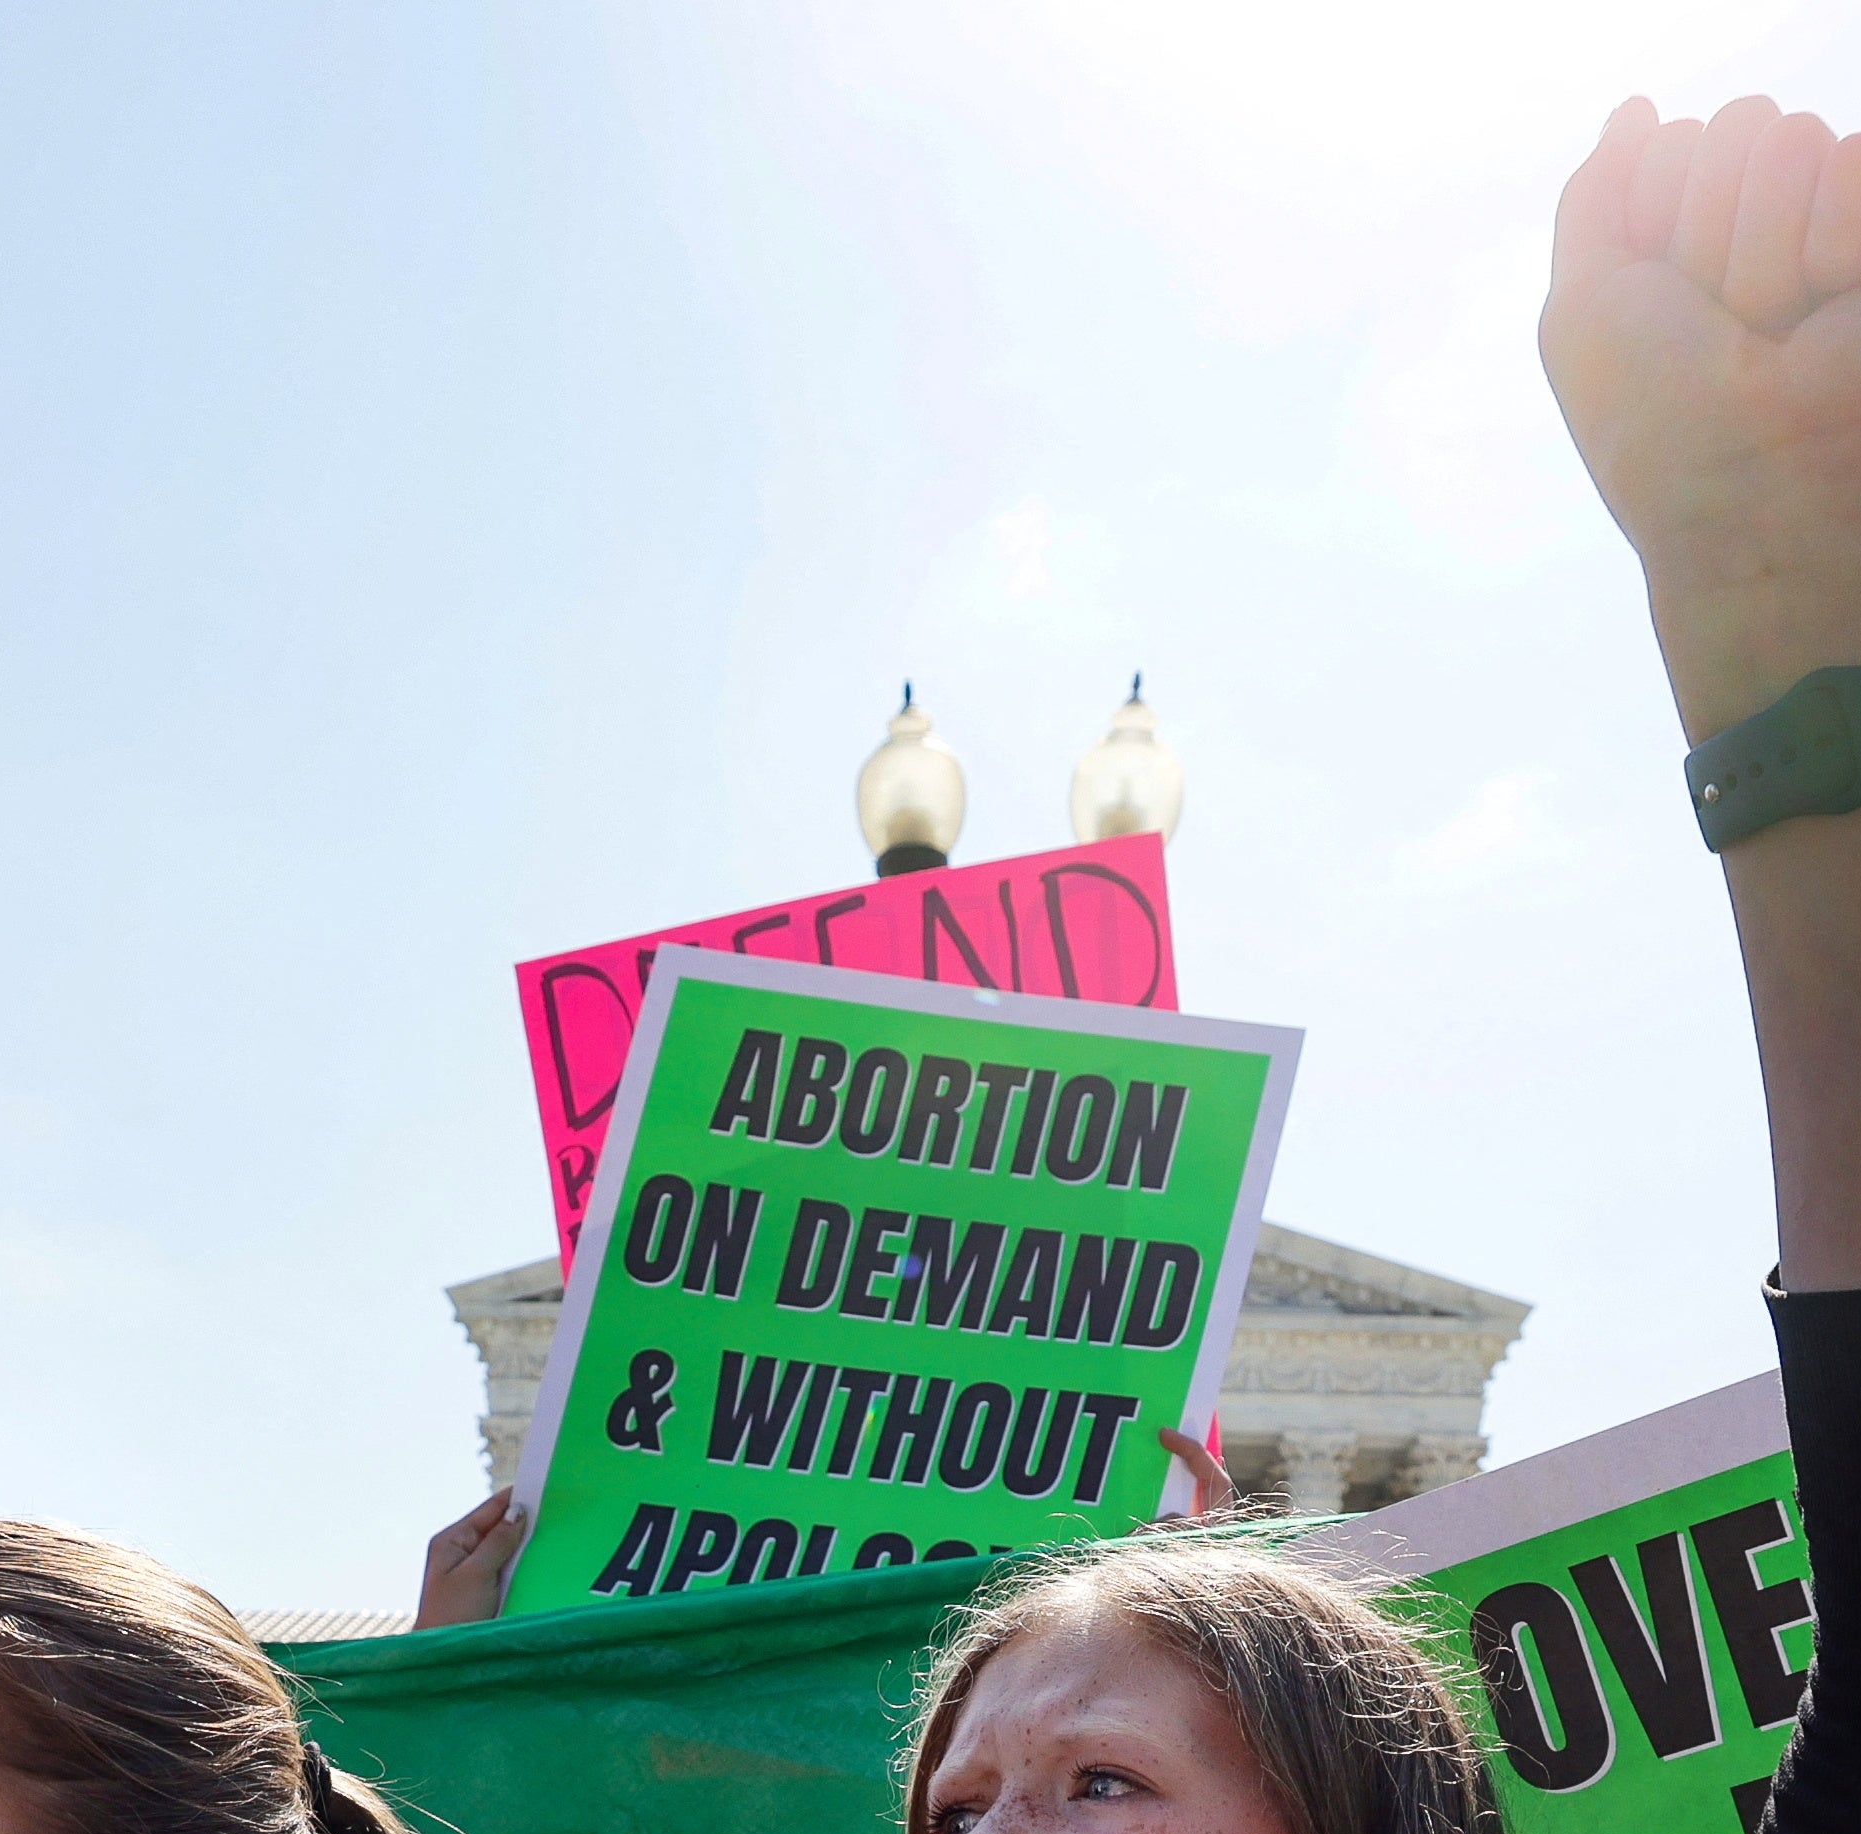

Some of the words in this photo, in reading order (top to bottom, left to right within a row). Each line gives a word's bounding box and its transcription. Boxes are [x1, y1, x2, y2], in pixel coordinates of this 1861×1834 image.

[709, 1028, 1190, 1193] ABORTION
[621, 1173, 765, 1302] ON
[775, 1196, 1205, 1352] DEMAND
[605, 1348, 677, 1455] &
[706, 1350, 1141, 1507] WITHOUT
